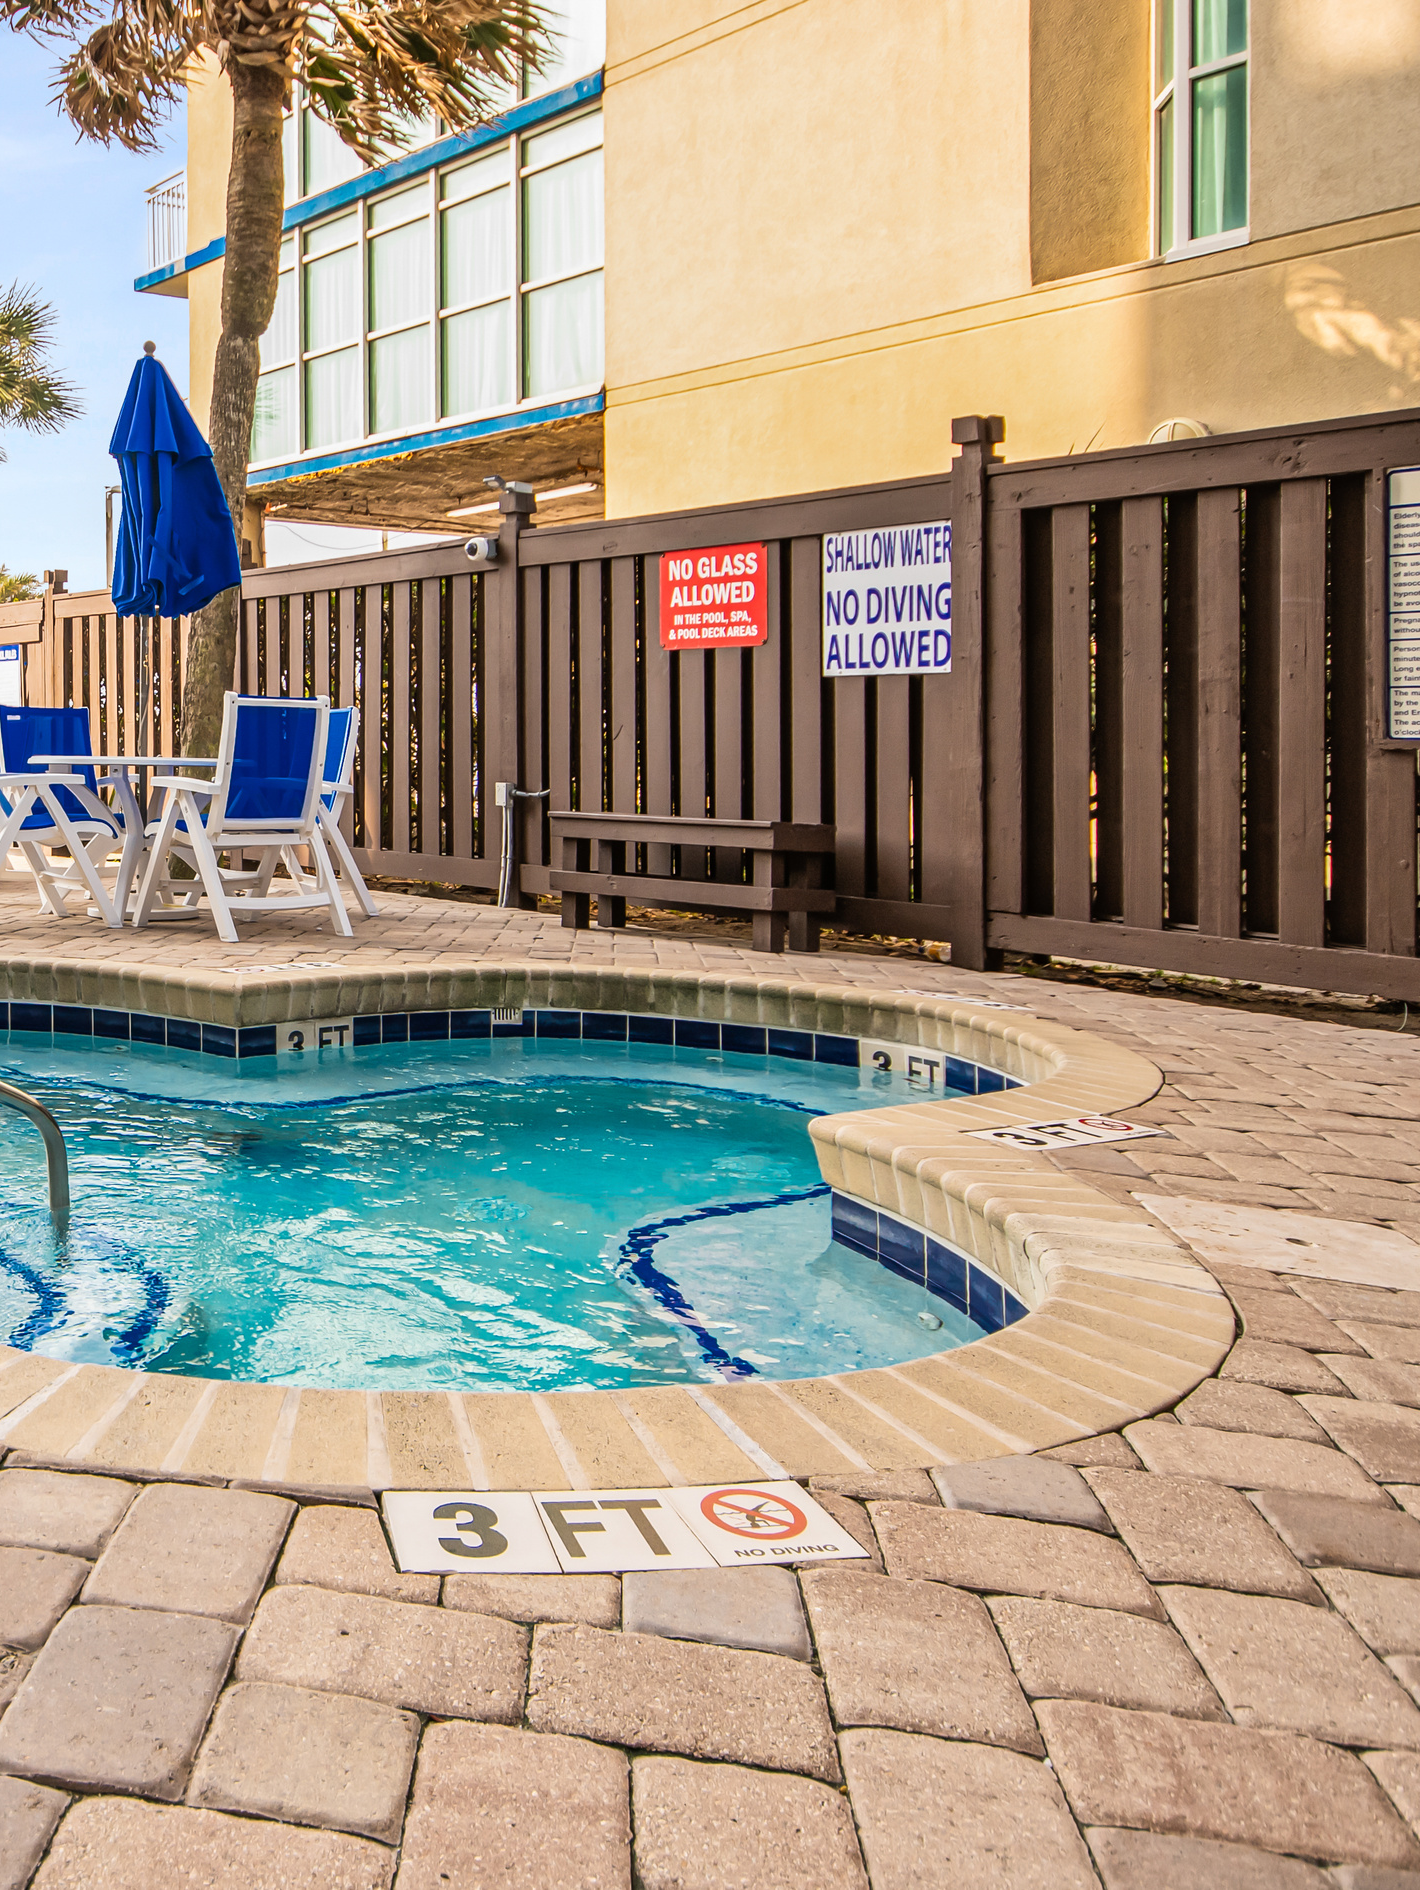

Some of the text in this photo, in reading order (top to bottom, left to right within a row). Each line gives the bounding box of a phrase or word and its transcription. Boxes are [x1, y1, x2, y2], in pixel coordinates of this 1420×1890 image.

[826, 524, 952, 574] SHALLOW WATER
[669, 552, 758, 581] NO GLASS
[670, 581, 755, 607] ALLOWED
[826, 581, 951, 626] NO DIVING
[674, 610, 752, 625] IN THE POOL, SPA,
[669, 624, 758, 640] & POOL DECK AREAS
[826, 629, 951, 670] ALLOWED
[1393, 700, 1404, 708] by
[288, 1024, 350, 1052] 3 FT
[872, 1050, 940, 1083] 3 FT
[992, 1123, 1103, 1146] 3 FT
[433, 1498, 672, 1559] 3 FT
[734, 1544, 840, 1558] NO DIVING
